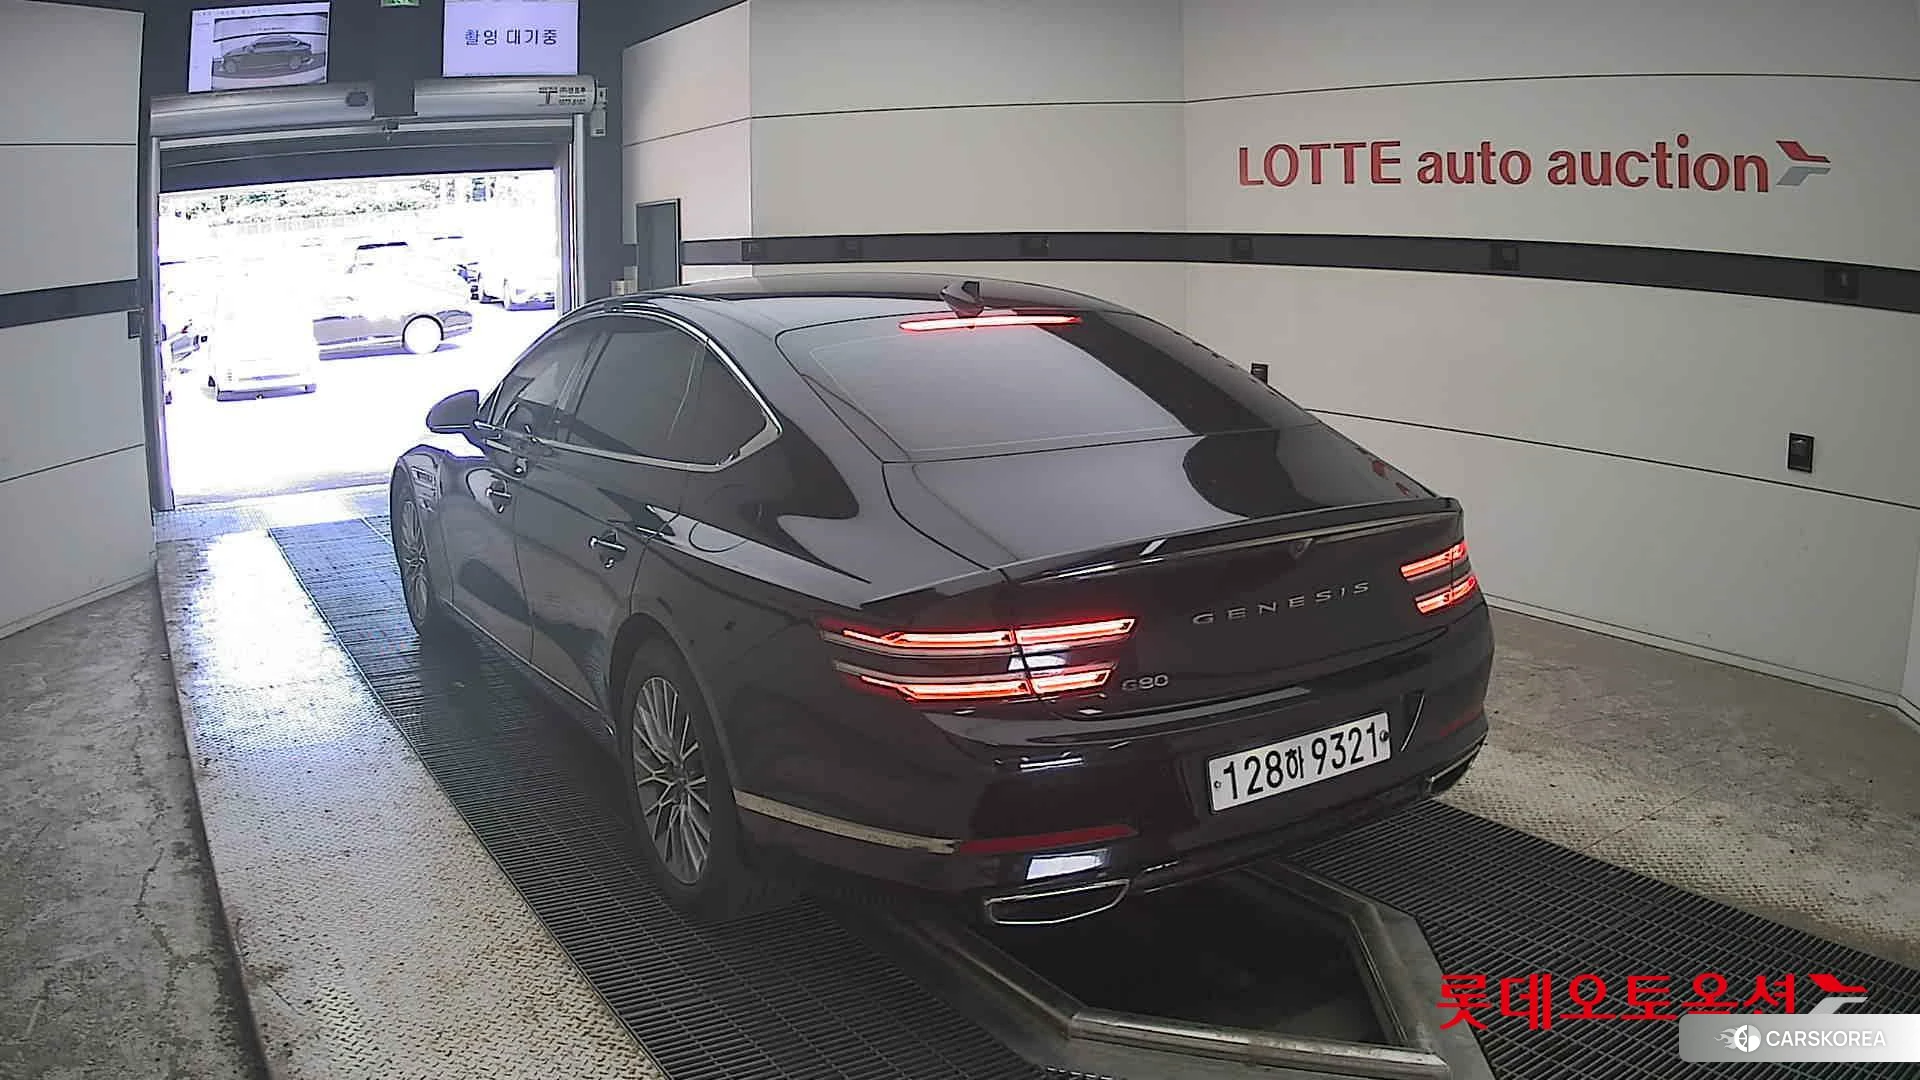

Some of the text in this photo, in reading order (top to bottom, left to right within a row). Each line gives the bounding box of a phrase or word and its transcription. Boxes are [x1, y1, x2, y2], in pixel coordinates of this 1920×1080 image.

[506, 28, 558, 46] 대기중
[1239, 133, 1769, 193] LOTTE auto auction
[1192, 582, 1369, 625] GENESIS
[1223, 722, 1377, 800] 128하 9321
